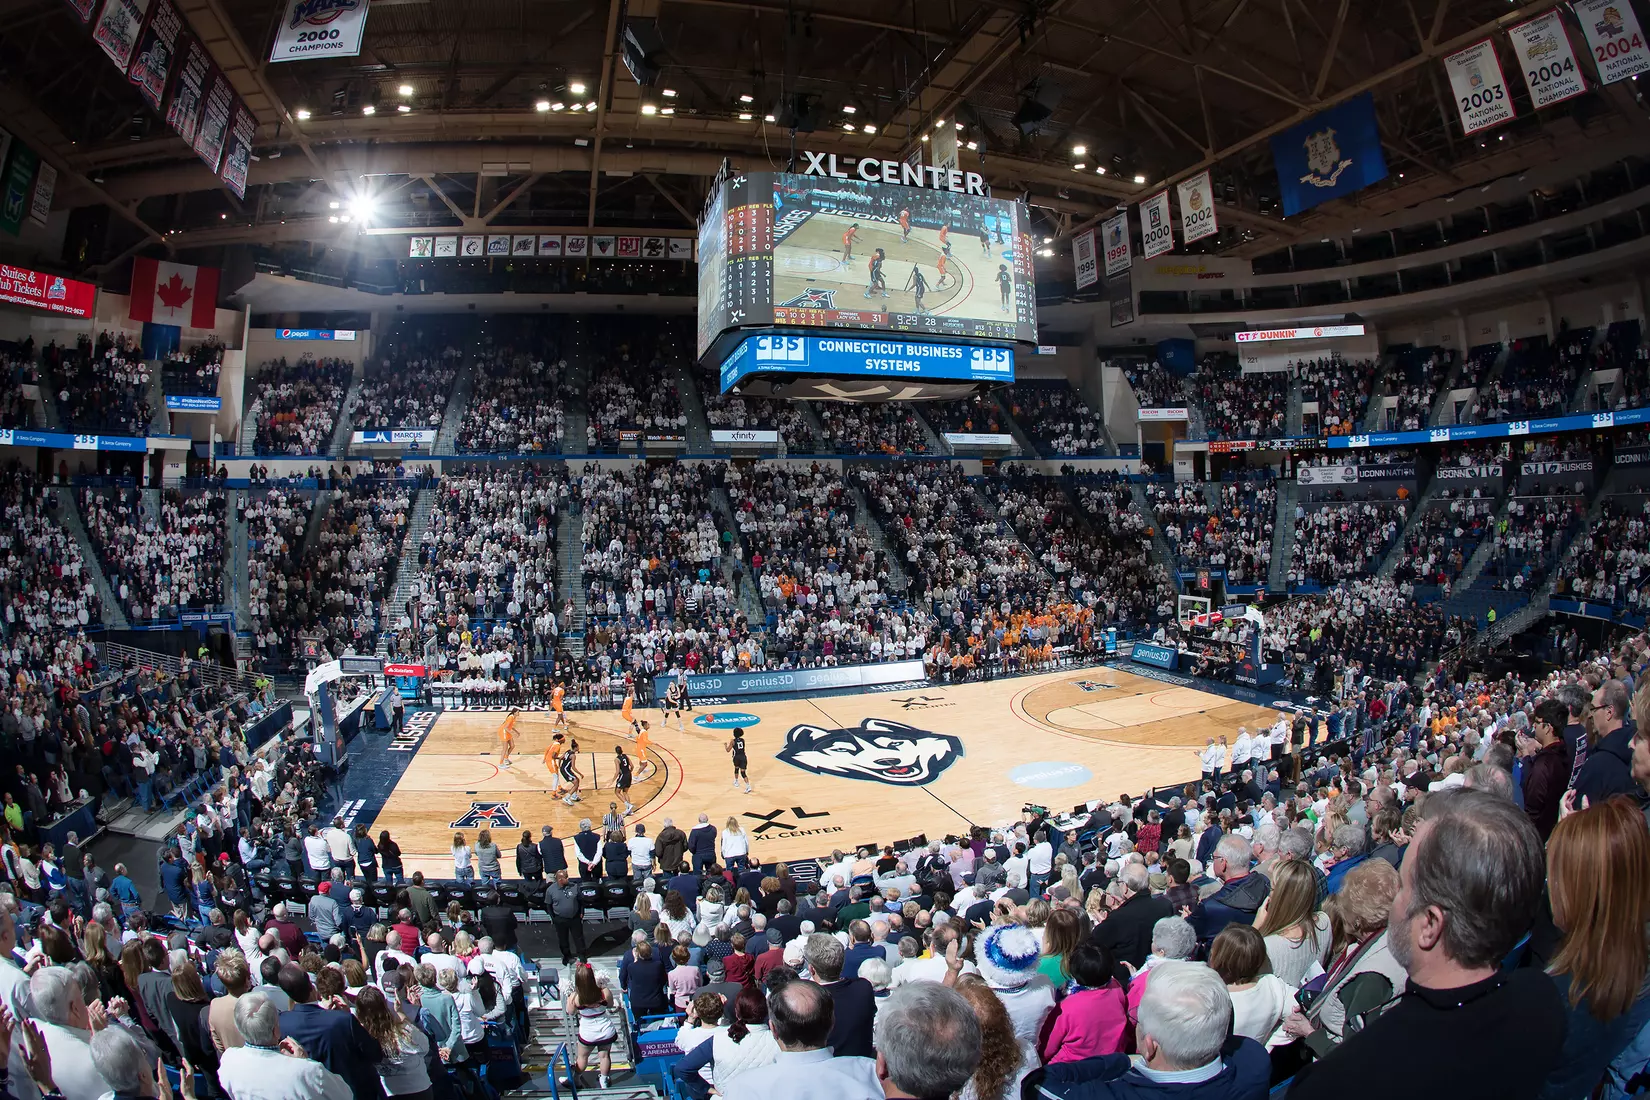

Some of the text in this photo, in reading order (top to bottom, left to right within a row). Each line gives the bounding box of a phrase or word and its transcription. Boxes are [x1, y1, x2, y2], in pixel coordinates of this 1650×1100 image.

[297, 29, 340, 43] 2000
[1523, 23, 1550, 38] Basketball
[289, 42, 344, 53] CHAMPIONS
[1595, 33, 1643, 62] 2004
[1457, 52, 1483, 66] Basketball
[1606, 54, 1643, 71] NATIONAL
[1528, 57, 1575, 87] 2004
[1607, 61, 1650, 82] CHAMPIONS
[1538, 76, 1574, 95] NATIONAL
[1461, 84, 1504, 112] 2003
[1538, 84, 1580, 105] CHAMPIONS
[1469, 103, 1503, 121] NATIONAL
[1469, 110, 1508, 130] CHAMPIONS
[804, 151, 985, 196] XL CENTER
[733, 176, 747, 189] XL
[1184, 207, 1212, 228] 2002
[1187, 227, 1214, 241] CHAMPIONS
[1188, 221, 1211, 233] NATIONAL
[1144, 225, 1170, 245] 2000
[1147, 244, 1171, 257] CHAMPIONS
[1148, 239, 1168, 250] NATIONAL
[1107, 244, 1127, 261] 1999
[1, 265, 36, 283] Suites &
[1077, 260, 1095, 276] 1995
[1108, 262, 1129, 274] CHAMPIONS
[13, 280, 42, 297] Tickets
[731, 310, 745, 323] XL
[872, 314, 882, 322] 31
[896, 314, 918, 326] 9:29
[925, 317, 937, 326] 28
[1238, 330, 1297, 341] CT DUNKIN'
[756, 336, 804, 353] CBS
[818, 340, 963, 359] CONNECTICUT BUSINESS
[970, 348, 1010, 364] CBS
[865, 357, 921, 371] SYSTEMS
[731, 431, 757, 441] xfinity
[1614, 454, 1640, 464] UCONN
[1359, 469, 1385, 478] UCONN
[1436, 469, 1466, 479] UCONN
[1560, 462, 1593, 472] HUSKIES
[1134, 648, 1169, 662] genius3D
[738, 674, 793, 690] genius3D
[387, 711, 437, 751] HUSKIES
[736, 741, 744, 750] 13
[623, 758, 628, 767] 3
[742, 806, 830, 834] XL
[778, 826, 844, 838] CENTER
